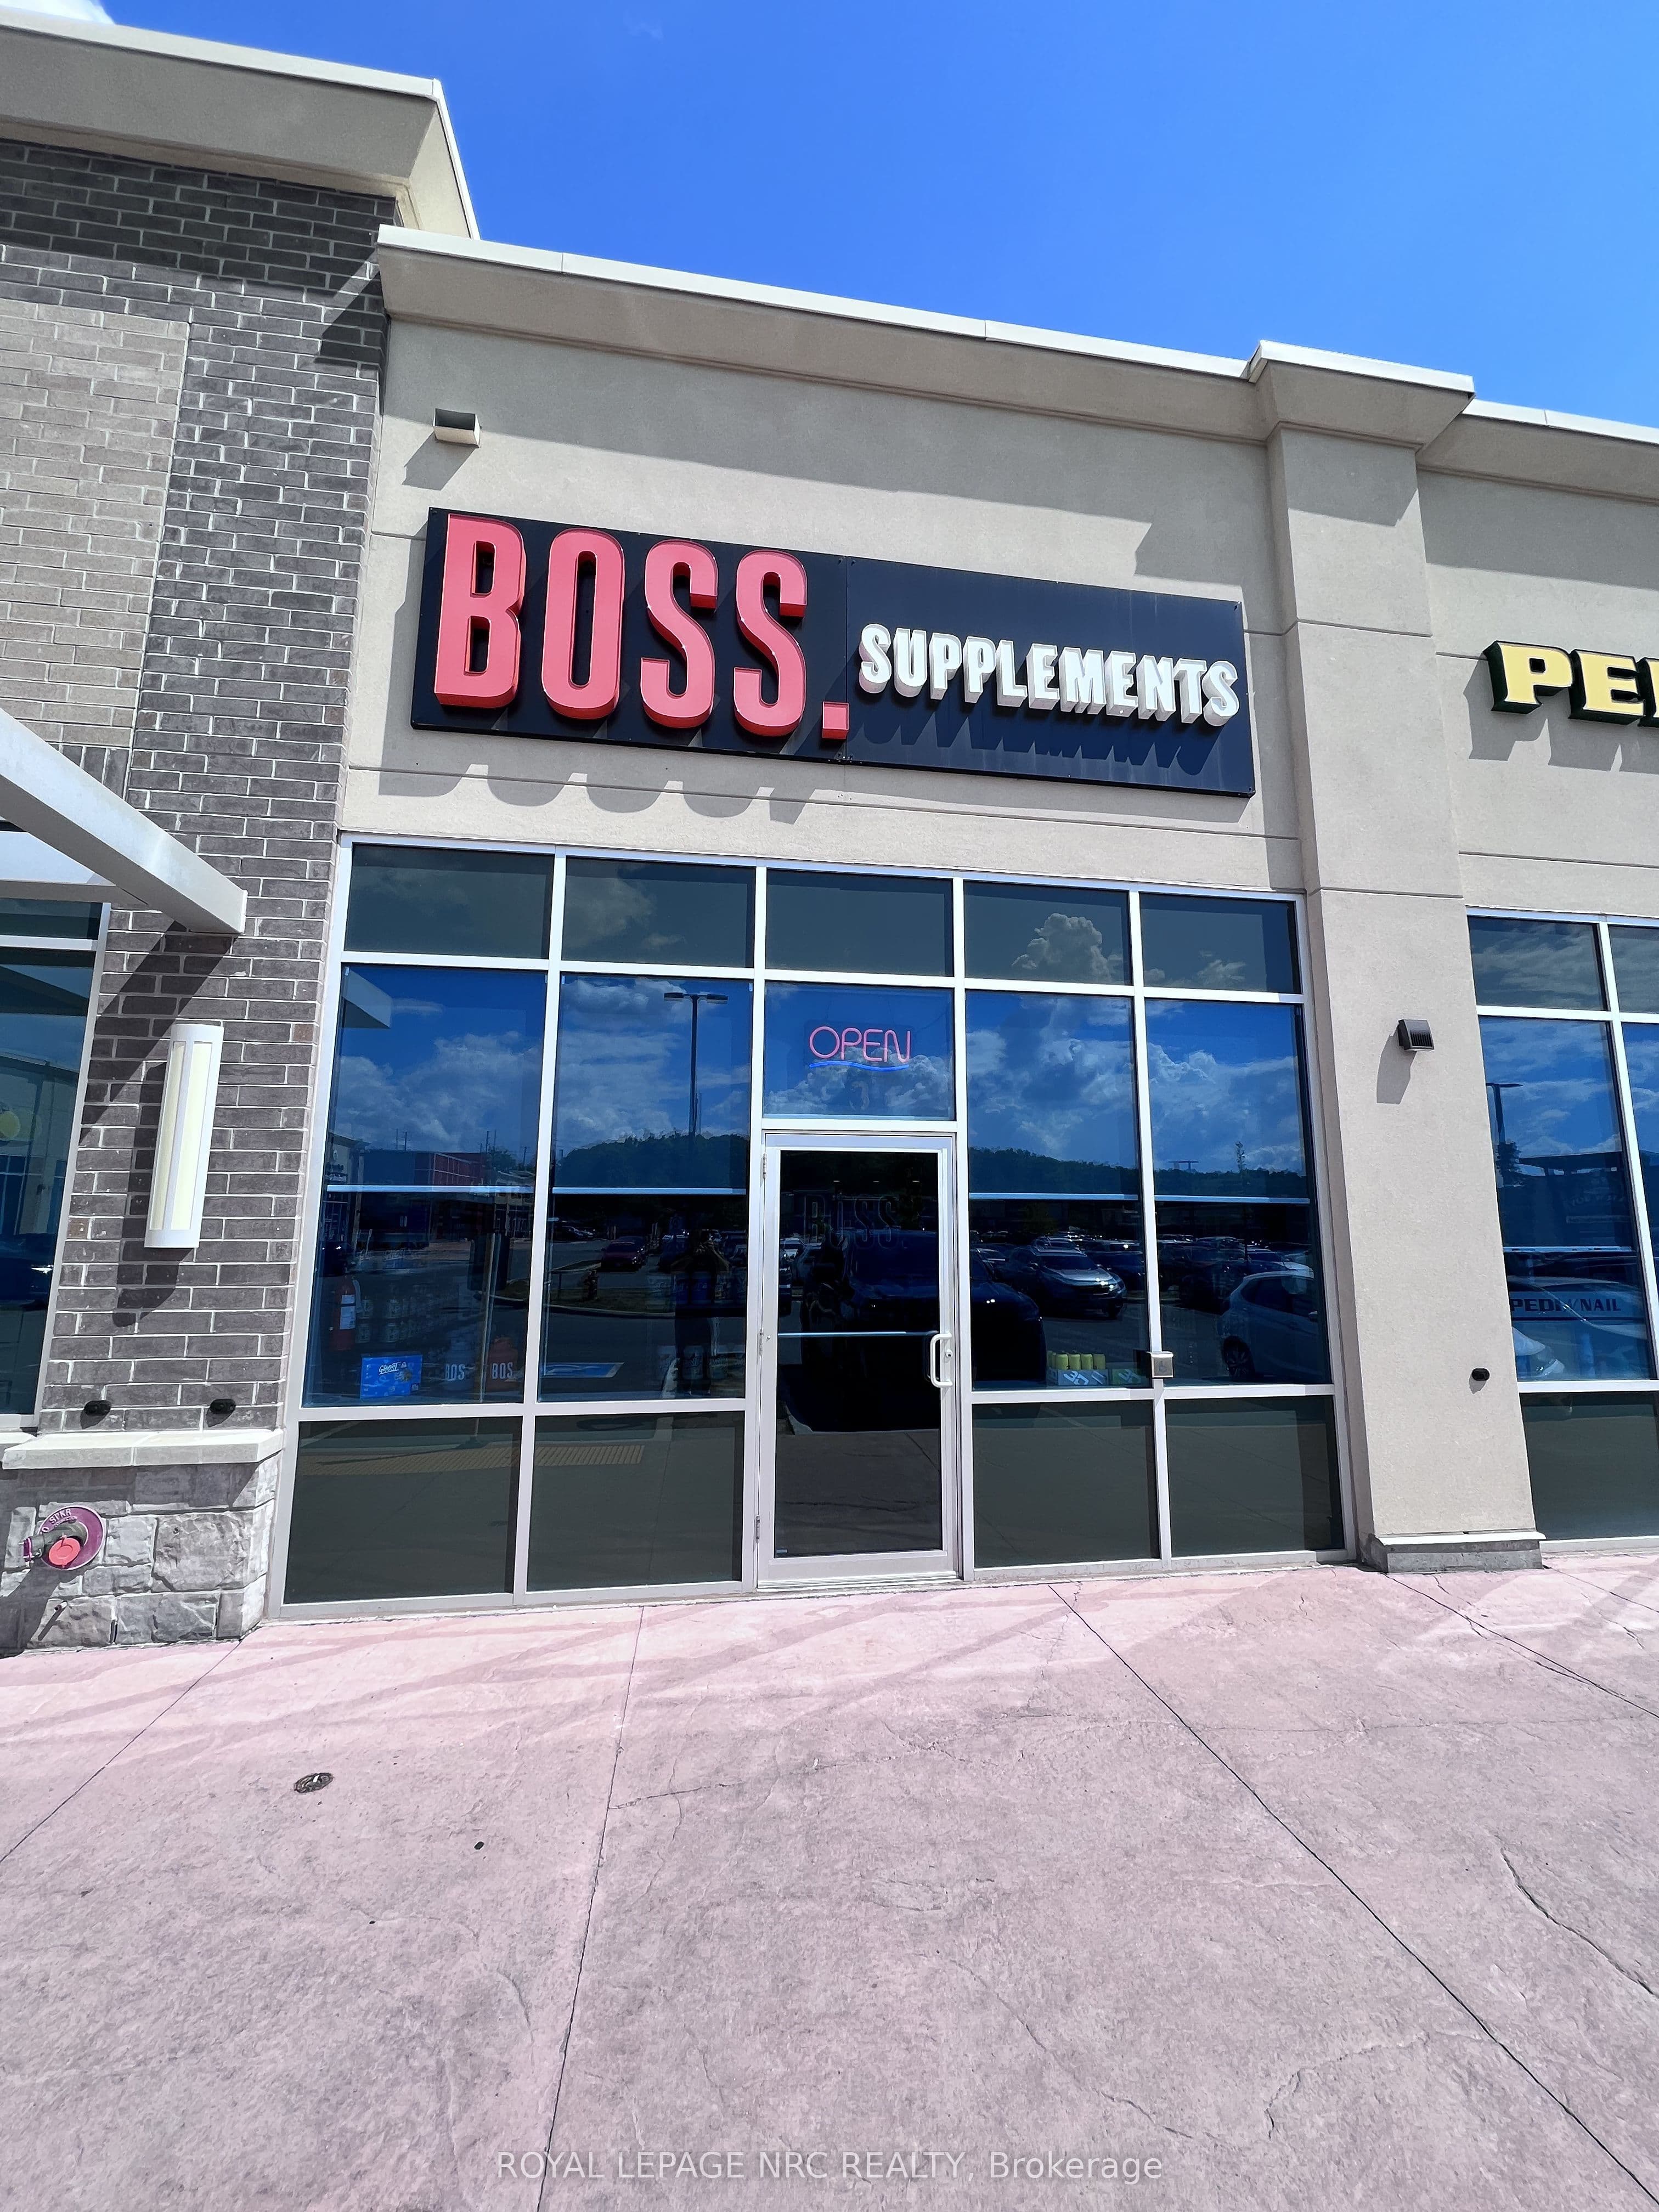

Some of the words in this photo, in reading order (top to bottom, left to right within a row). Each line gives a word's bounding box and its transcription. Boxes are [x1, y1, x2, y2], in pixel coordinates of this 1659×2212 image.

[435, 514, 850, 740] BOSS.
[859, 623, 1240, 726] SUPPLEMENTS
[1483, 640, 1659, 728] PE
[809, 1026, 911, 1063] OPEN
[1579, 1299, 1621, 1312] NAIL
[379, 1361, 401, 1374] GHOST
